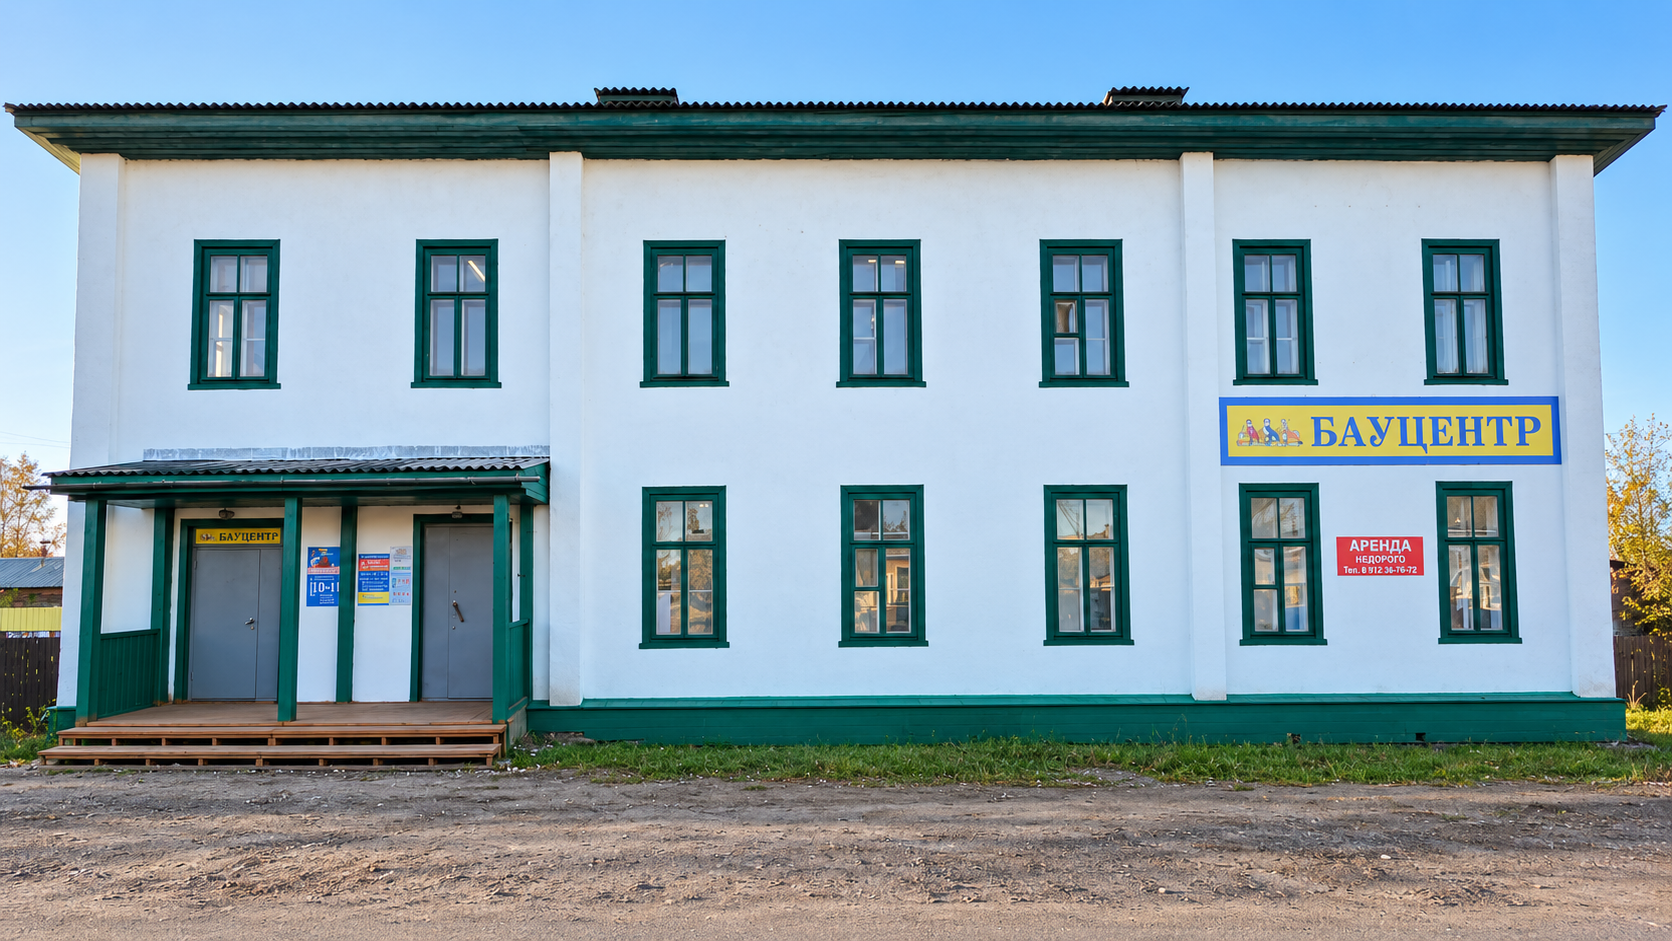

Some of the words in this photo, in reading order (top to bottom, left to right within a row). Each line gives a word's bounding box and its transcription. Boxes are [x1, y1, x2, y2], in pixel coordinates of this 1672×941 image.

[1310, 416, 1542, 454] БАУЦЕНТР
[219, 532, 279, 542] БАУЦЕНТР
[1349, 539, 1412, 554] АРЕНДА
[1355, 555, 1406, 564] НЕДОРОГО
